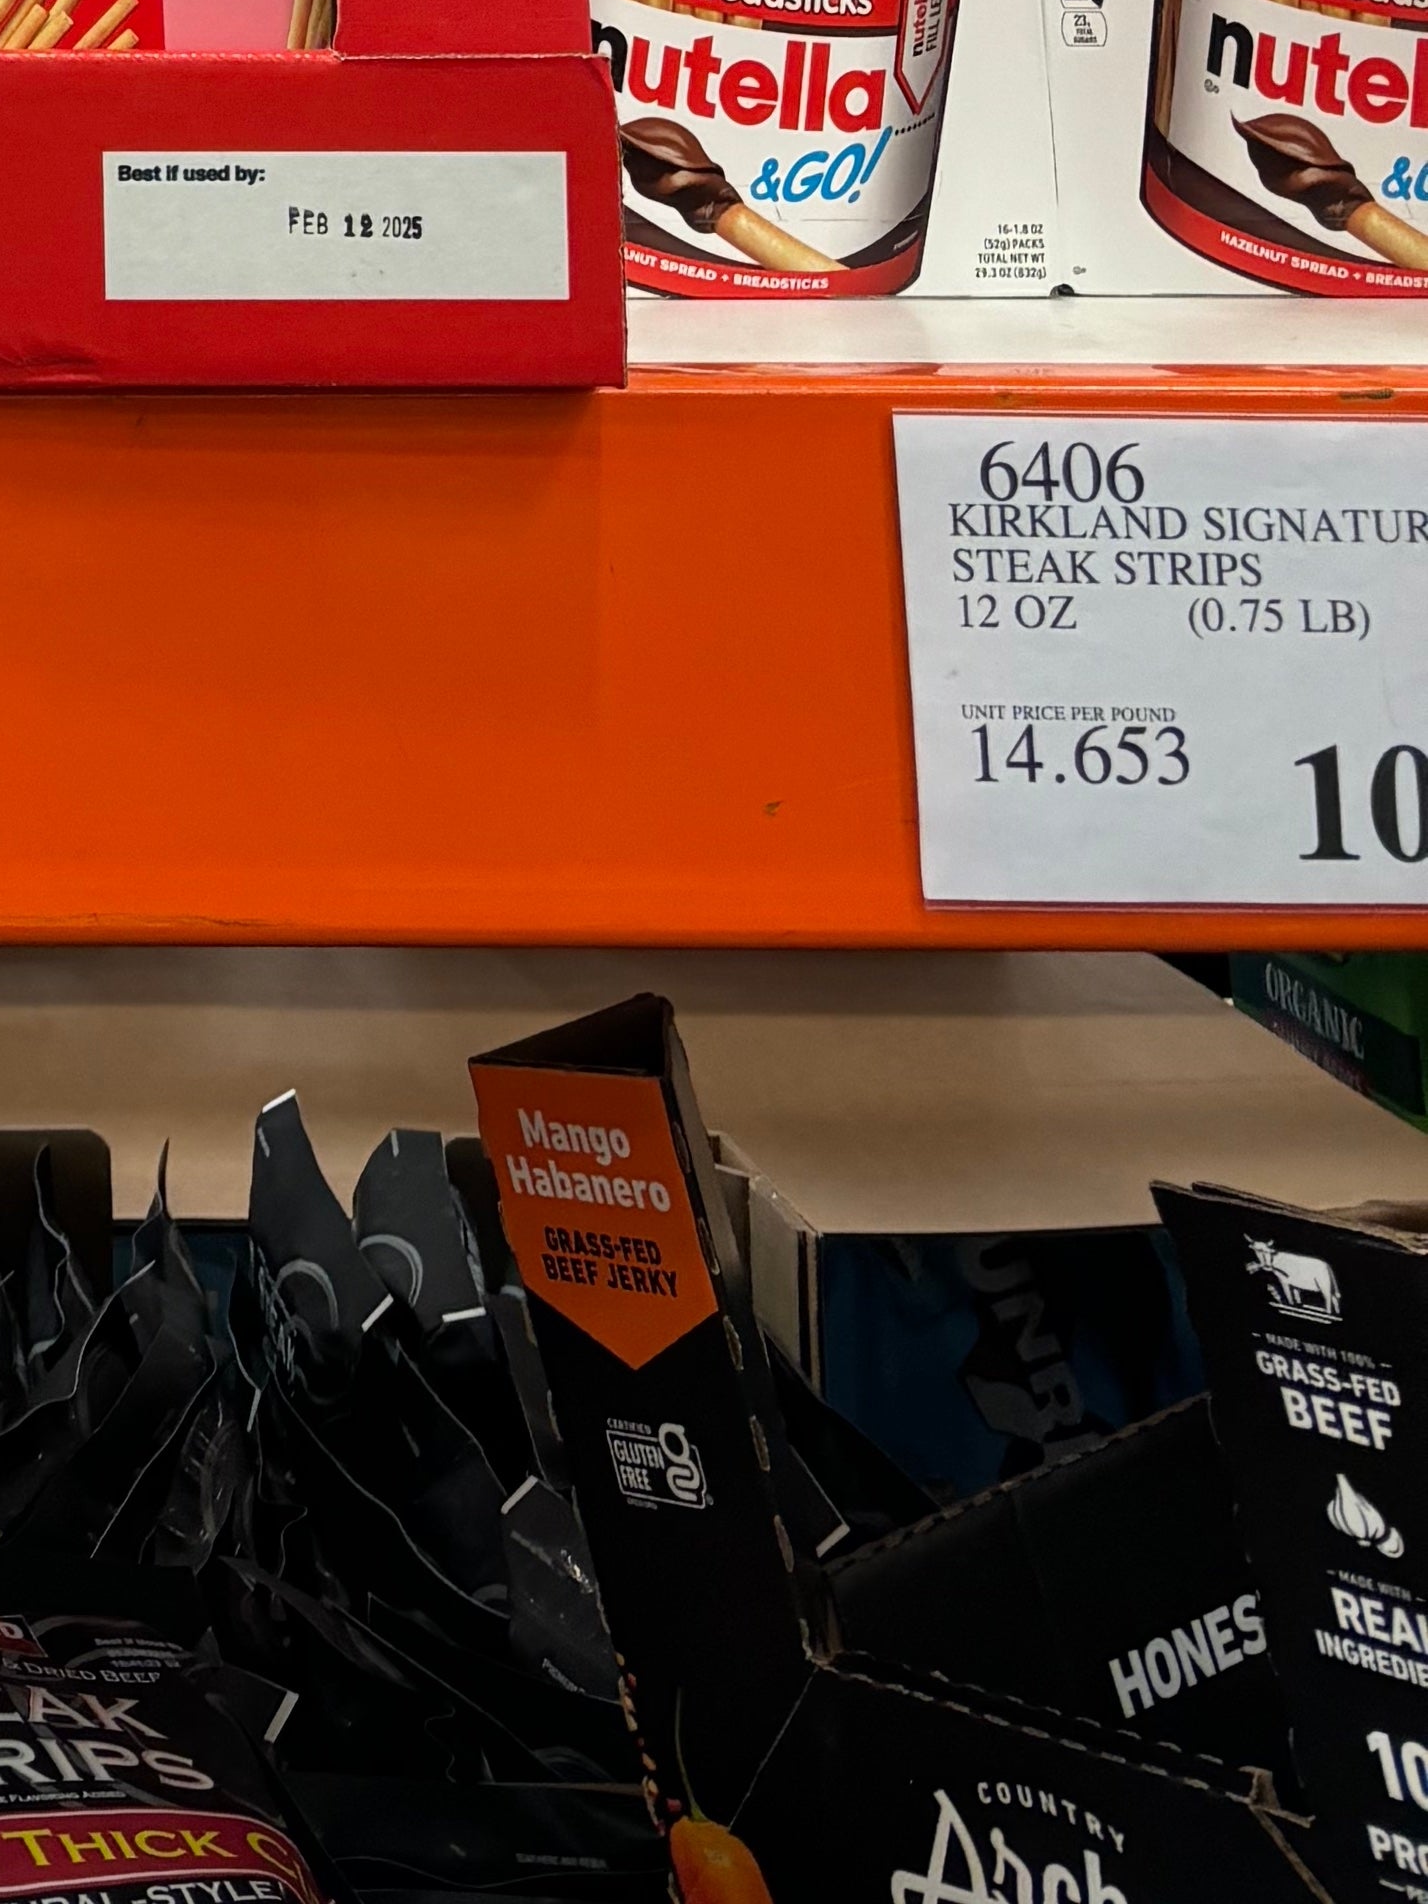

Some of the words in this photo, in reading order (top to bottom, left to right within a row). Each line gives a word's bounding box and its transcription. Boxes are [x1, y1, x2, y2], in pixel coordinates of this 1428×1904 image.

[118, 165, 161, 182] Best
[165, 165, 178, 182] if
[183, 165, 230, 182] used
[235, 165, 266, 185] by:
[750, 126, 893, 204] &GO!
[288, 206, 329, 235] FEB
[382, 215, 423, 240] 2025
[979, 440, 1145, 504] 6406
[949, 503, 1187, 540] KIRKLAND
[952, 548, 1101, 585] STEAK
[1114, 552, 1263, 587] STRIPS
[959, 594, 999, 628] 12
[1014, 595, 1078, 630] OZ
[1187, 597, 1284, 639] (0.75
[1301, 599, 1371, 640] LB)
[962, 704, 1005, 721] UNIT
[1012, 705, 1066, 722] PRICE
[1070, 706, 1106, 722] PER
[1110, 706, 1176, 723] POUND
[971, 724, 1191, 786] 14.653
[1263, 962, 1365, 1061] ORGANIC
[516, 1108, 632, 1168] Mango
[505, 1155, 672, 1212] Habanero
[543, 1225, 663, 1268] GRASS-FED
[541, 1252, 601, 1286] BEEF
[606, 1261, 680, 1299] JERKY
[1255, 1350, 1402, 1407] GRASS-FED
[1279, 1387, 1393, 1451] BEEF
[612, 1438, 665, 1473] GLUTEN
[618, 1464, 654, 1494] FREE
[1109, 1593, 1268, 1718] HONES
[977, 1783, 1126, 1855] COUNTRY
[0, 1829, 240, 1867] THICK
